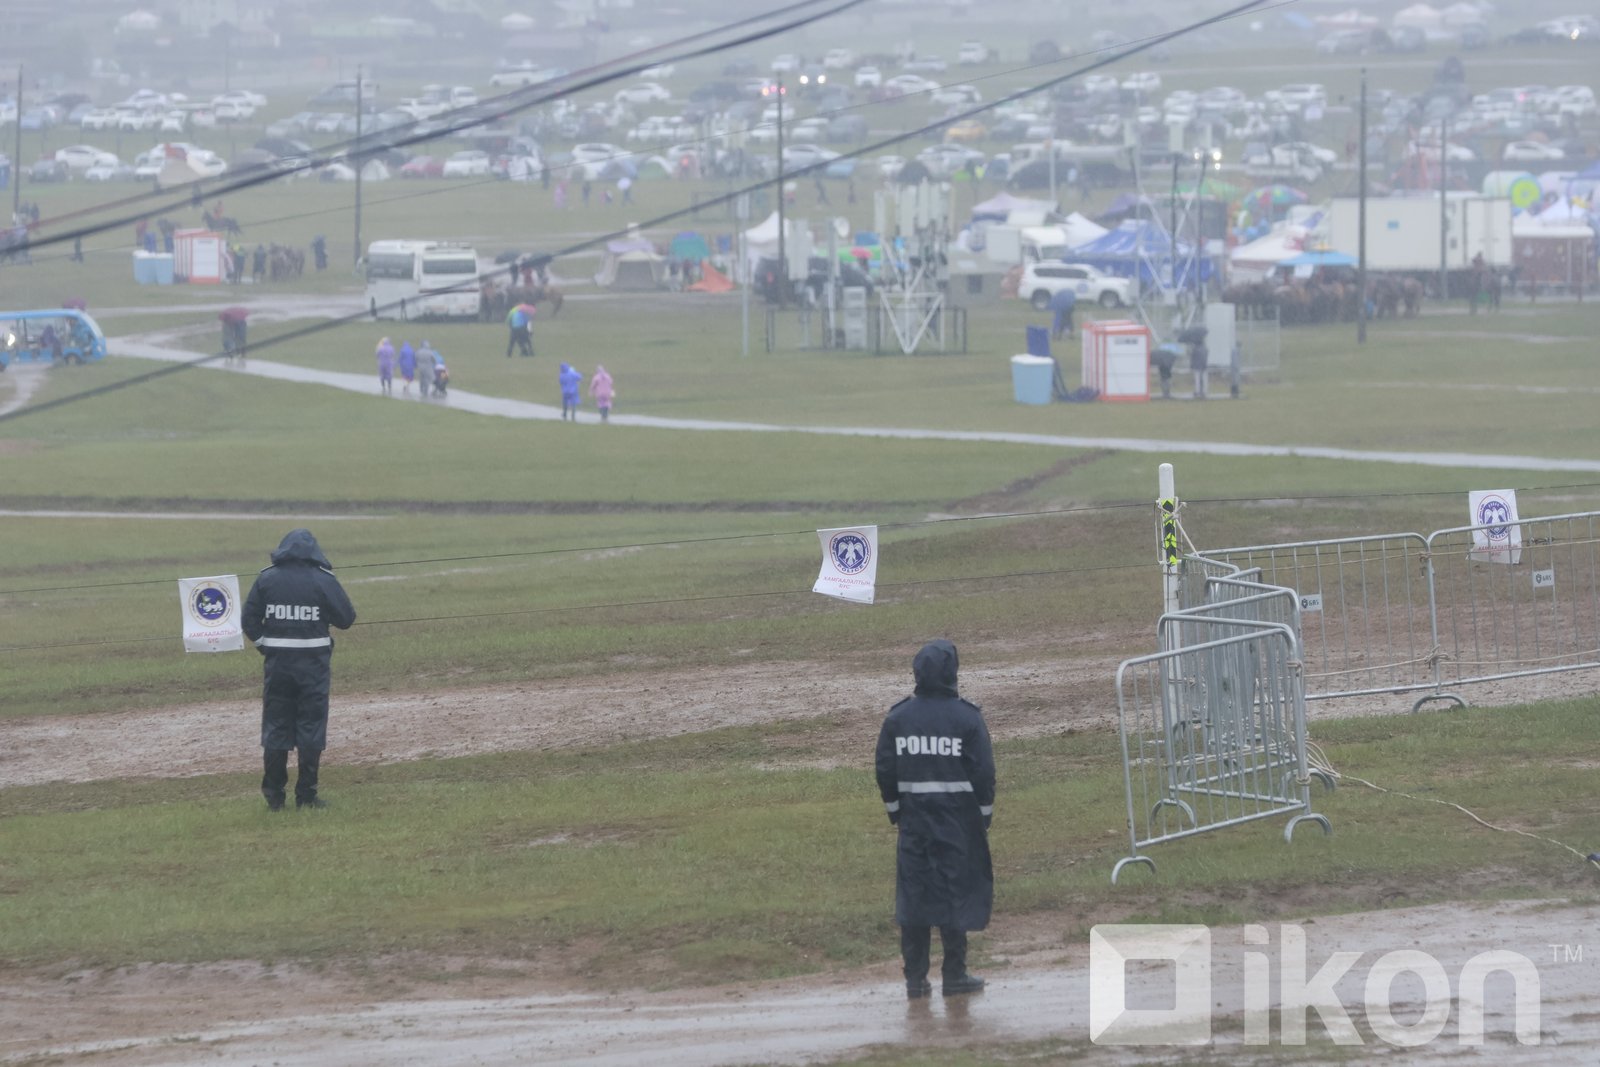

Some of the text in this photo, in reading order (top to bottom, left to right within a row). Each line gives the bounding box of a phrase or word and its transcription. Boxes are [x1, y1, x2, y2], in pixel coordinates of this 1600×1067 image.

[837, 563, 864, 573] POLICE
[265, 604, 320, 621] POLICE
[895, 736, 962, 757] POLICE
